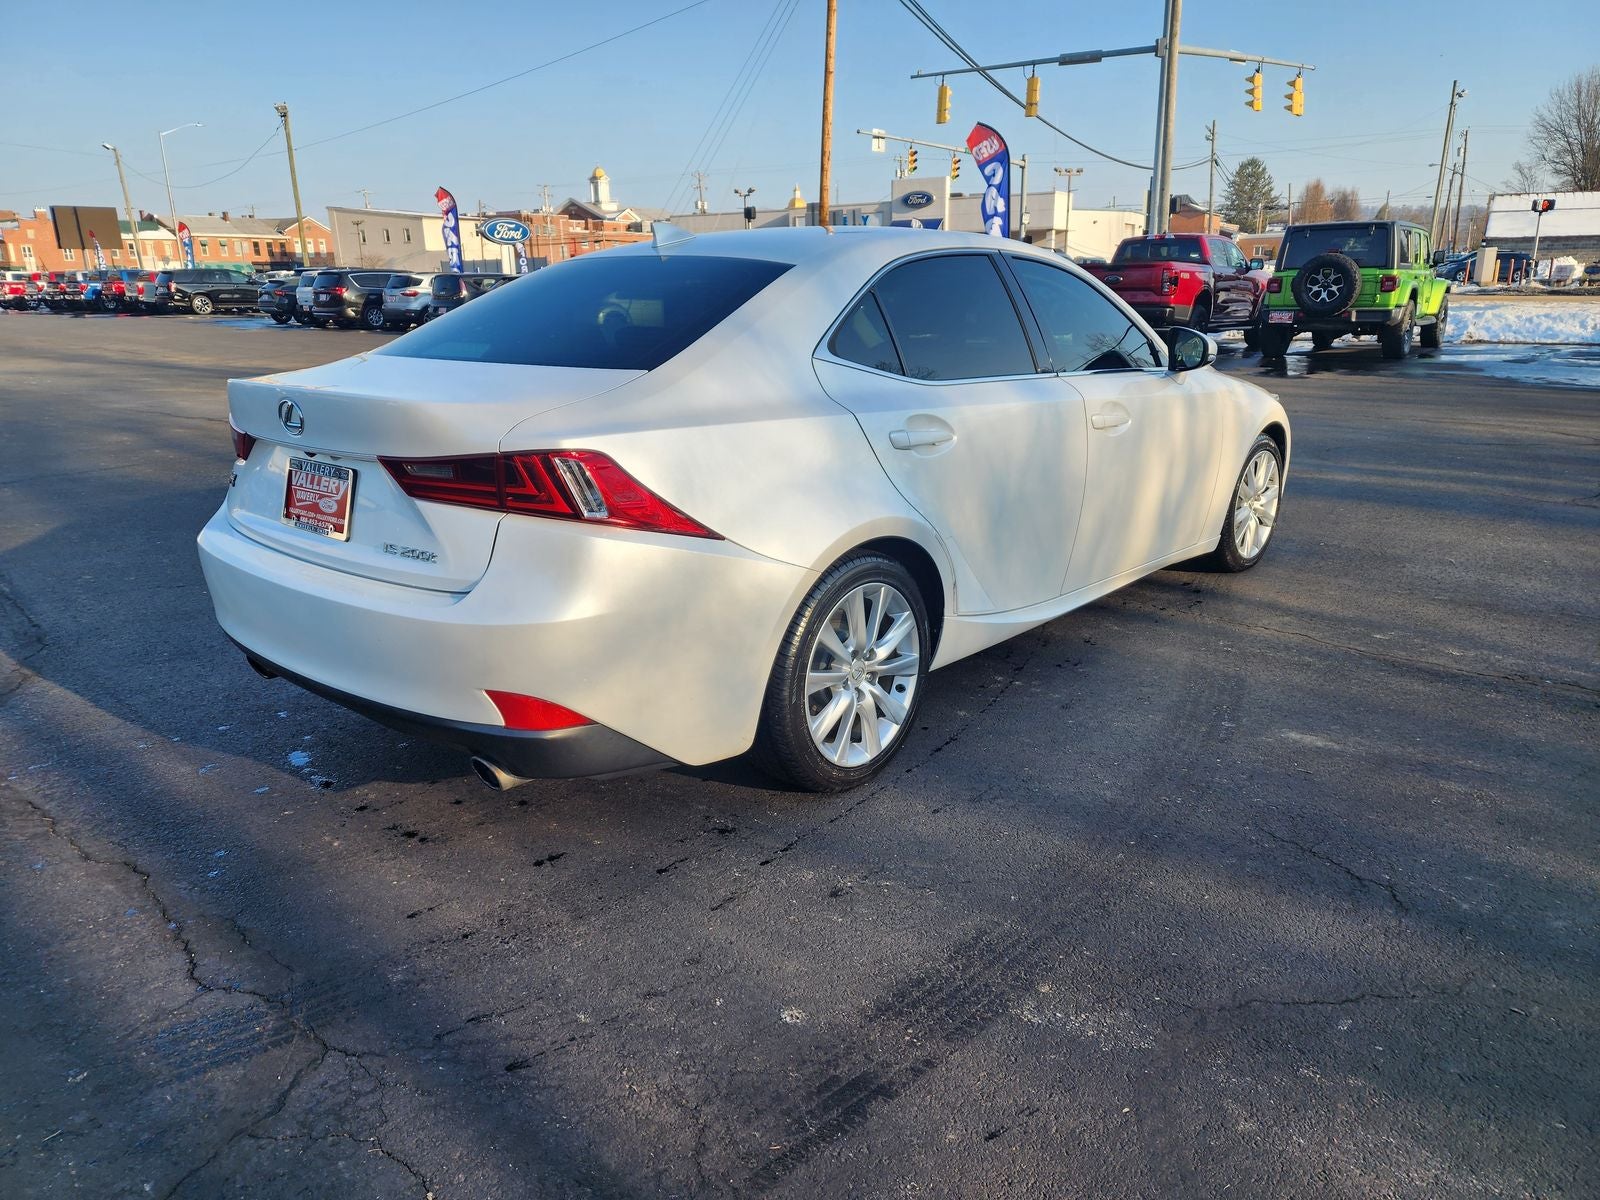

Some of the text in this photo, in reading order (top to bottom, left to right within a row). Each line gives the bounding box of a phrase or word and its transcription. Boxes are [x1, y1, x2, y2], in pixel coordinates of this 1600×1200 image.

[907, 194, 928, 204] Ford
[494, 222, 523, 240] Ford
[302, 460, 335, 477] VALLERY
[291, 470, 349, 498] VALLERY
[383, 542, 398, 555] IS
